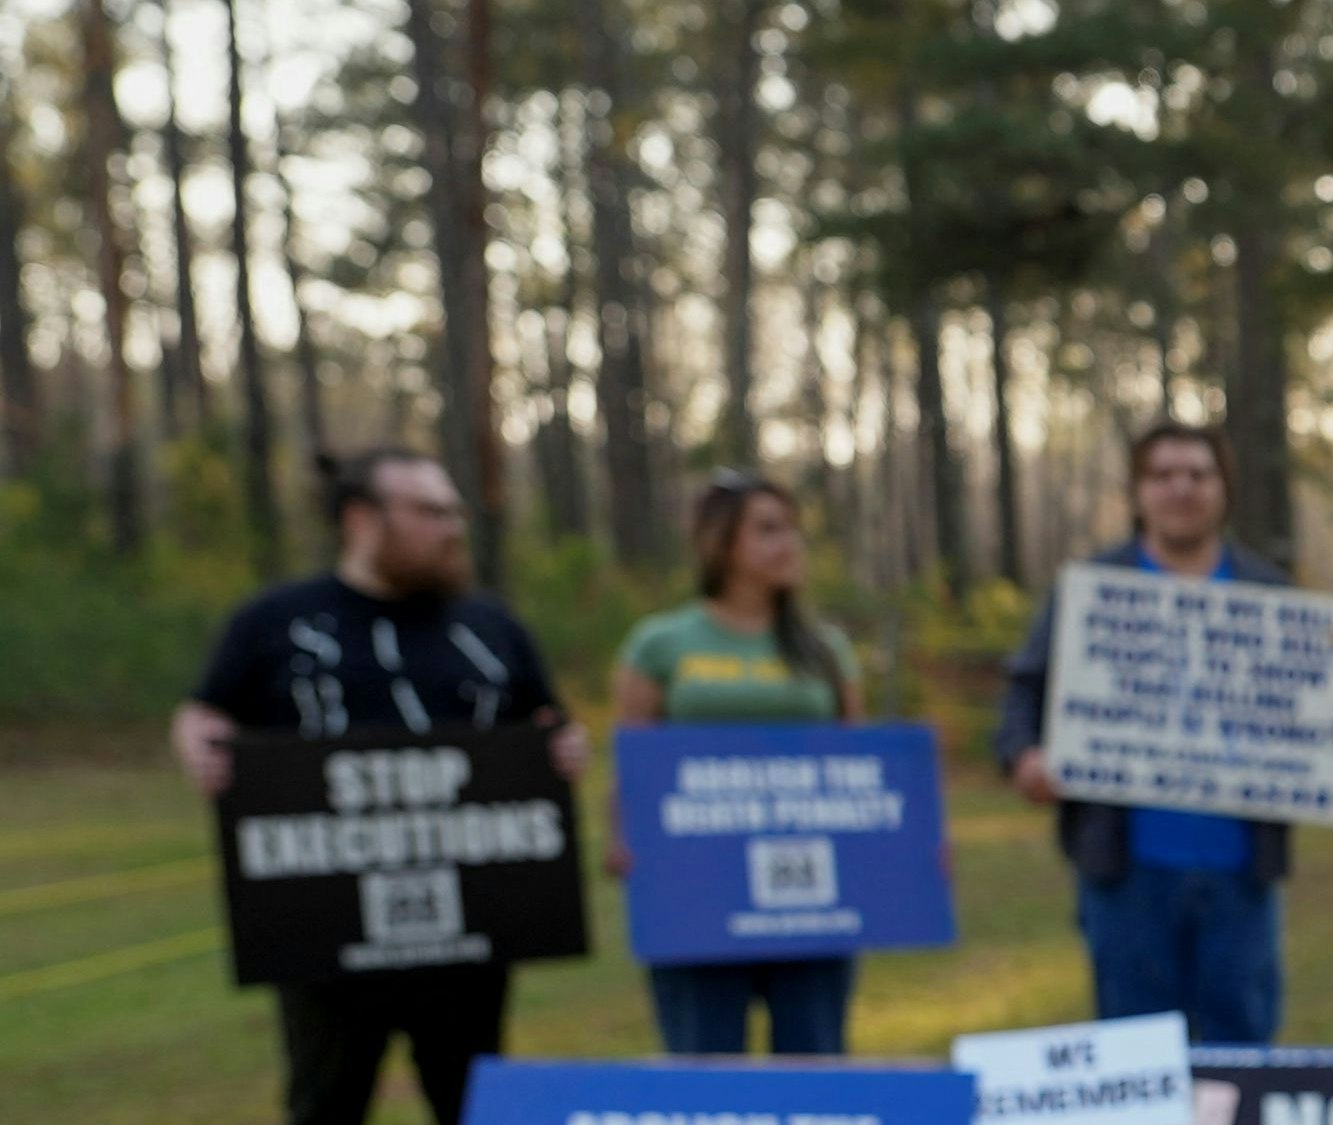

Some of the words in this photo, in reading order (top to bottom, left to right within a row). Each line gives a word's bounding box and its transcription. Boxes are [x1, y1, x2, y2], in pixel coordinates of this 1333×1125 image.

[326, 750, 469, 811] STOP
[682, 758, 816, 790] ABOLISH
[827, 757, 880, 787] THE
[664, 797, 764, 834] DEATH
[776, 793, 901, 831] PENALTY
[238, 802, 562, 878] EXECUTIONS
[1045, 1039, 1097, 1070] WE
[981, 1074, 1174, 1116] EMEMBER
